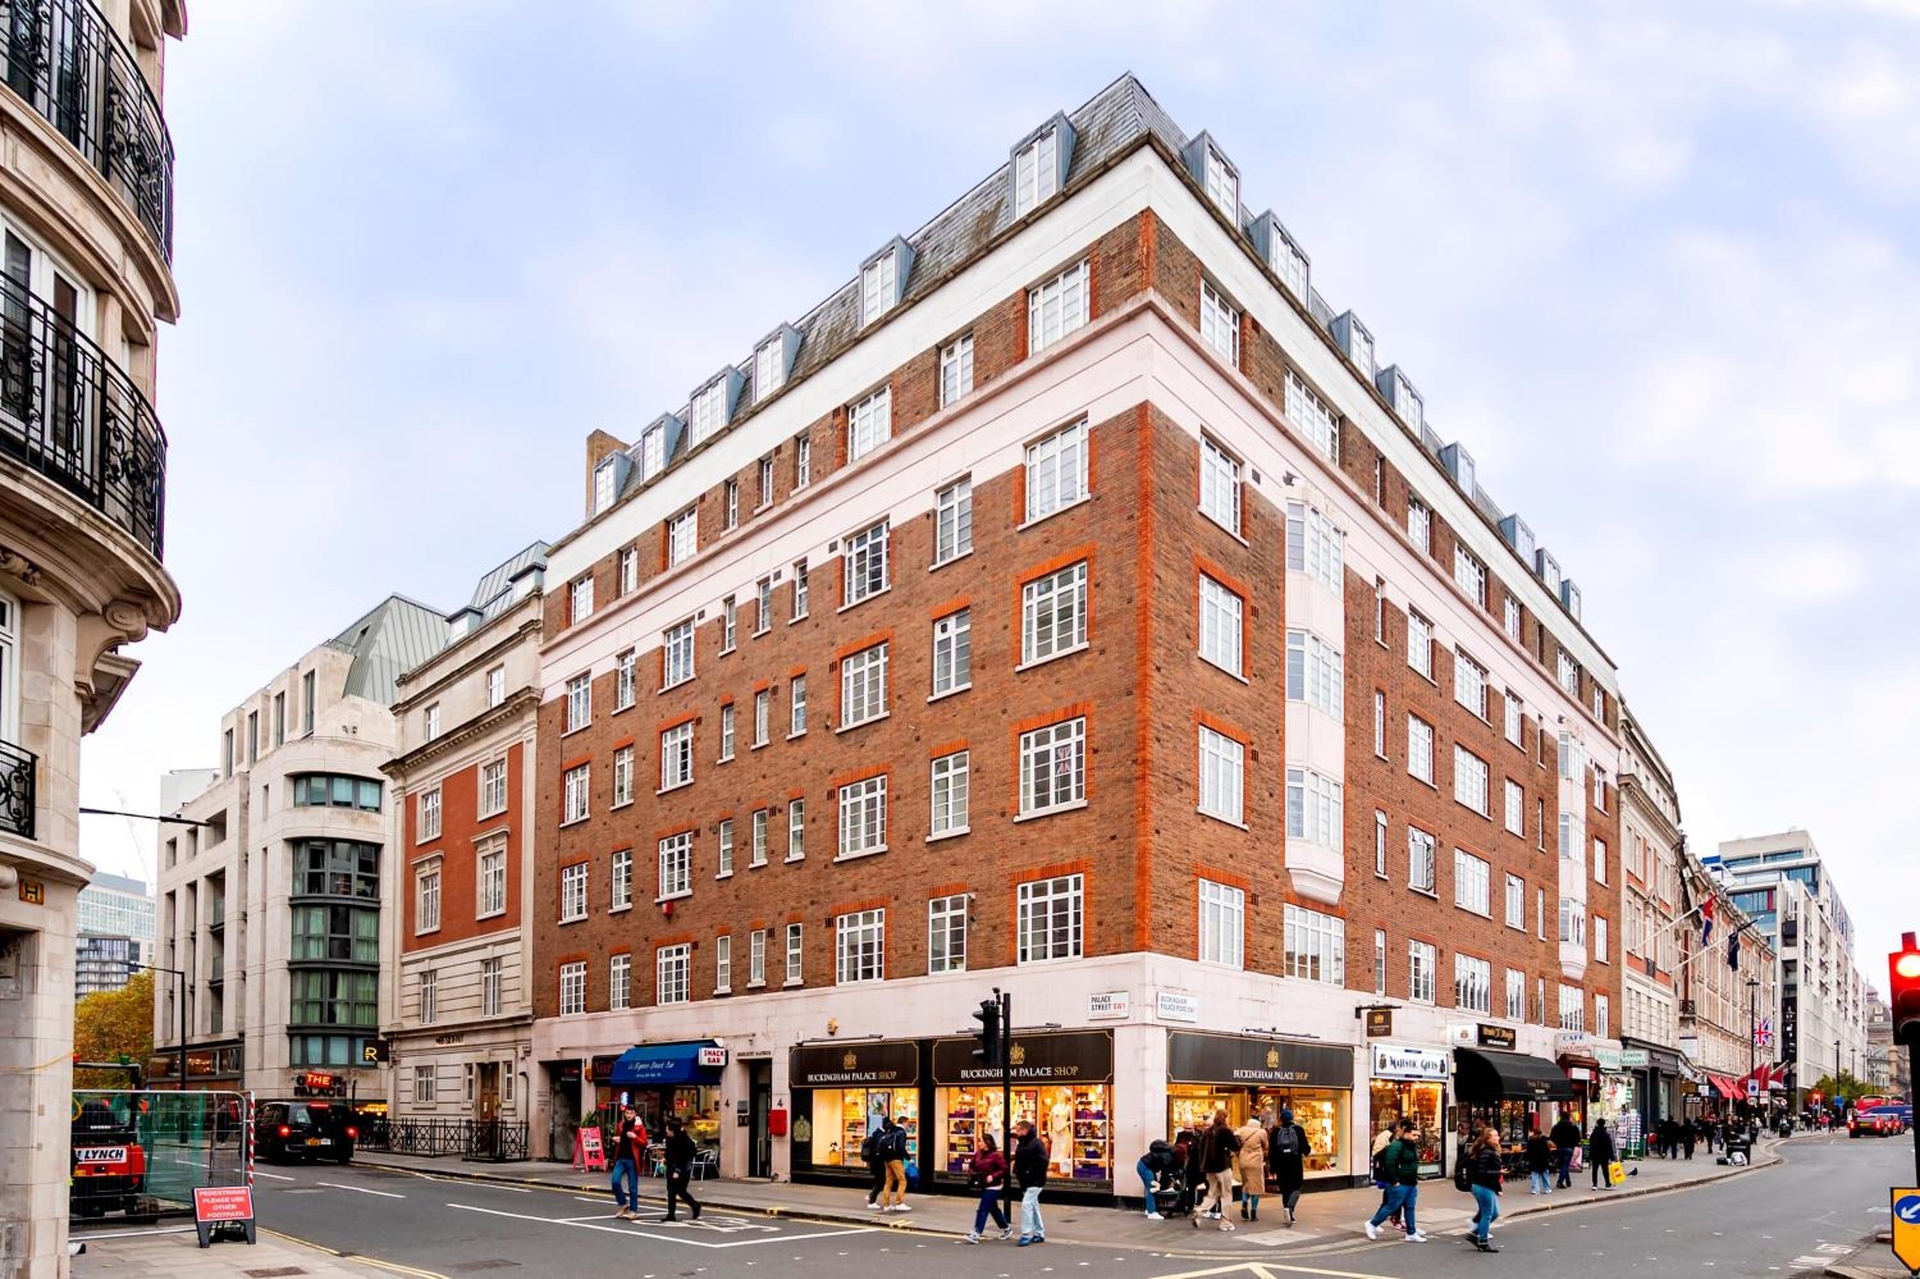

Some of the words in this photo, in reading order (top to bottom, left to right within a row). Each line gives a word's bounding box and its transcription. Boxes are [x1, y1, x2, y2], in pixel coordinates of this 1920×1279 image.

[1091, 1003, 1111, 1011] STREET
[704, 1049, 724, 1057] SNACK
[807, 1073, 851, 1082] BUCKINGHAM
[852, 1072, 877, 1081] PALACE
[878, 1071, 897, 1080] SHOP
[961, 1068, 1017, 1079] BUCKINGHM
[1019, 1067, 1052, 1077] PALACE
[1054, 1065, 1079, 1076] SHOP
[1233, 1069, 1273, 1079] BUCKINGHAM
[1274, 1071, 1294, 1080] PALACE
[1294, 1072, 1309, 1080] SHOP
[306, 1073, 331, 1085] THE
[725, 1099, 730, 1107] 4
[778, 1099, 783, 1107] 4
[85, 1150, 124, 1159] LYNCH
